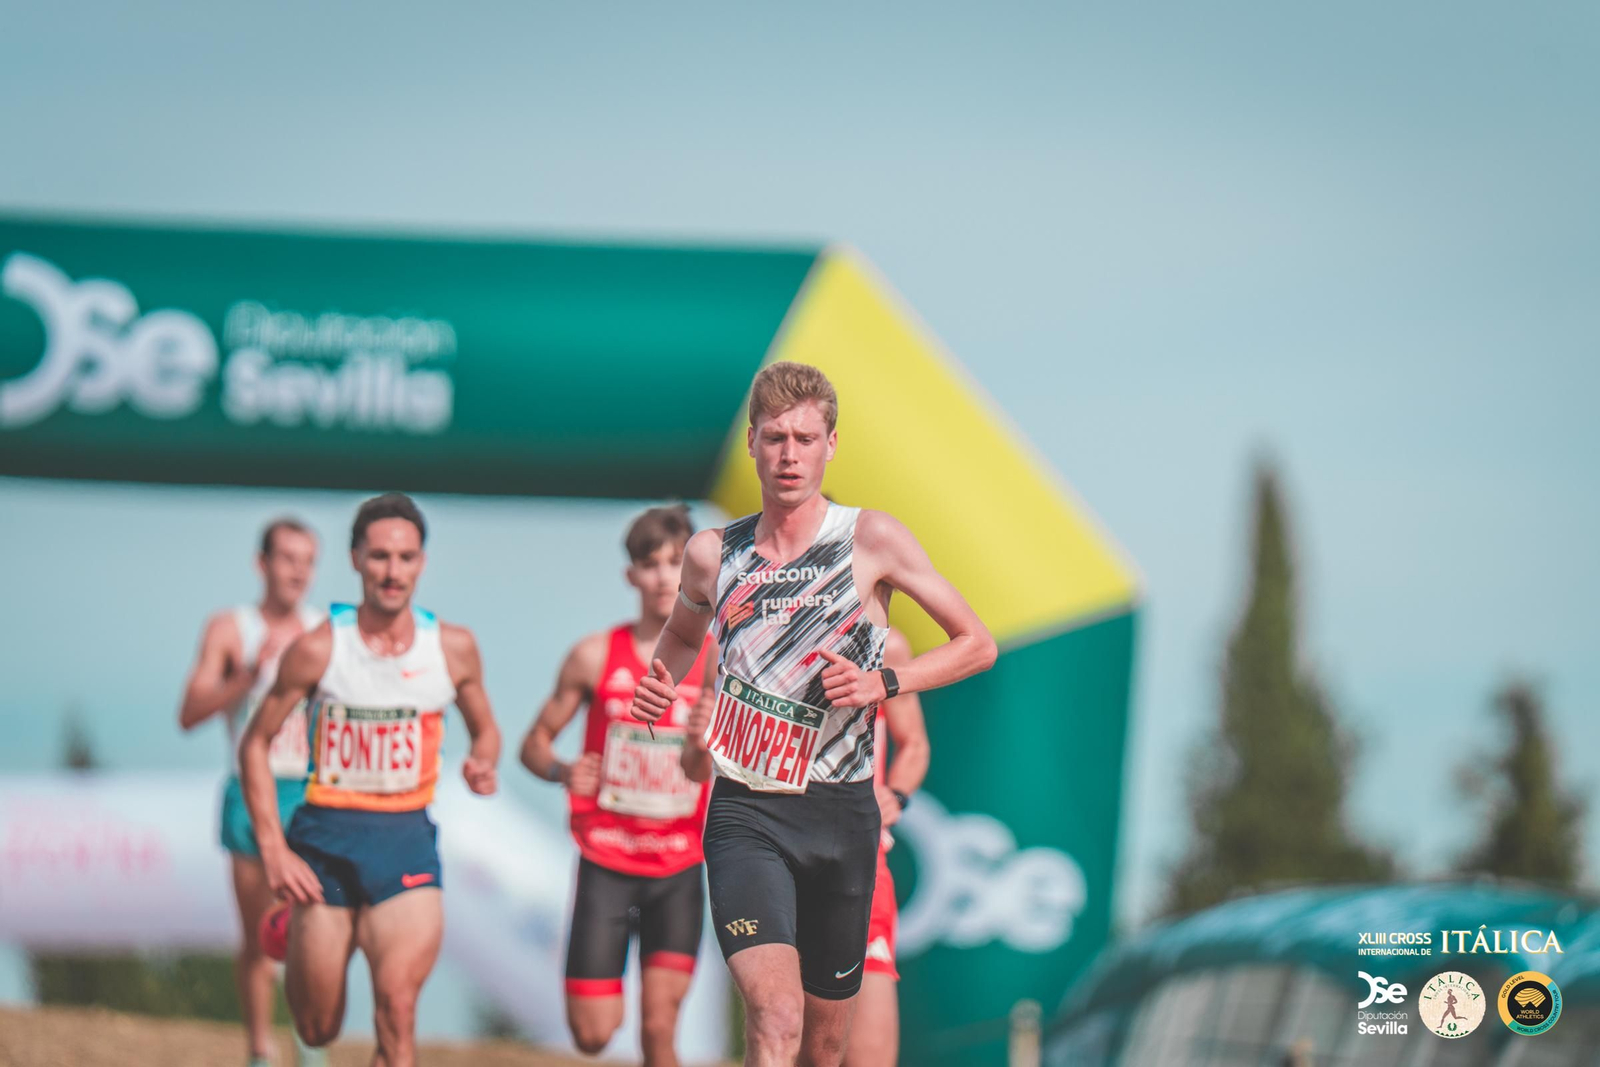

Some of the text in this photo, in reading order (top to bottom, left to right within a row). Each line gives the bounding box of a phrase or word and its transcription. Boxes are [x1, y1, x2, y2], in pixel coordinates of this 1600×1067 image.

[221, 346, 455, 434] Sevilla
[737, 565, 826, 587] saucony
[761, 609, 791, 626] lab
[745, 689, 795, 718] ITÁLICA
[325, 721, 415, 771] FONTES
[707, 692, 819, 788] VANOPPEN
[725, 918, 759, 937] WF
